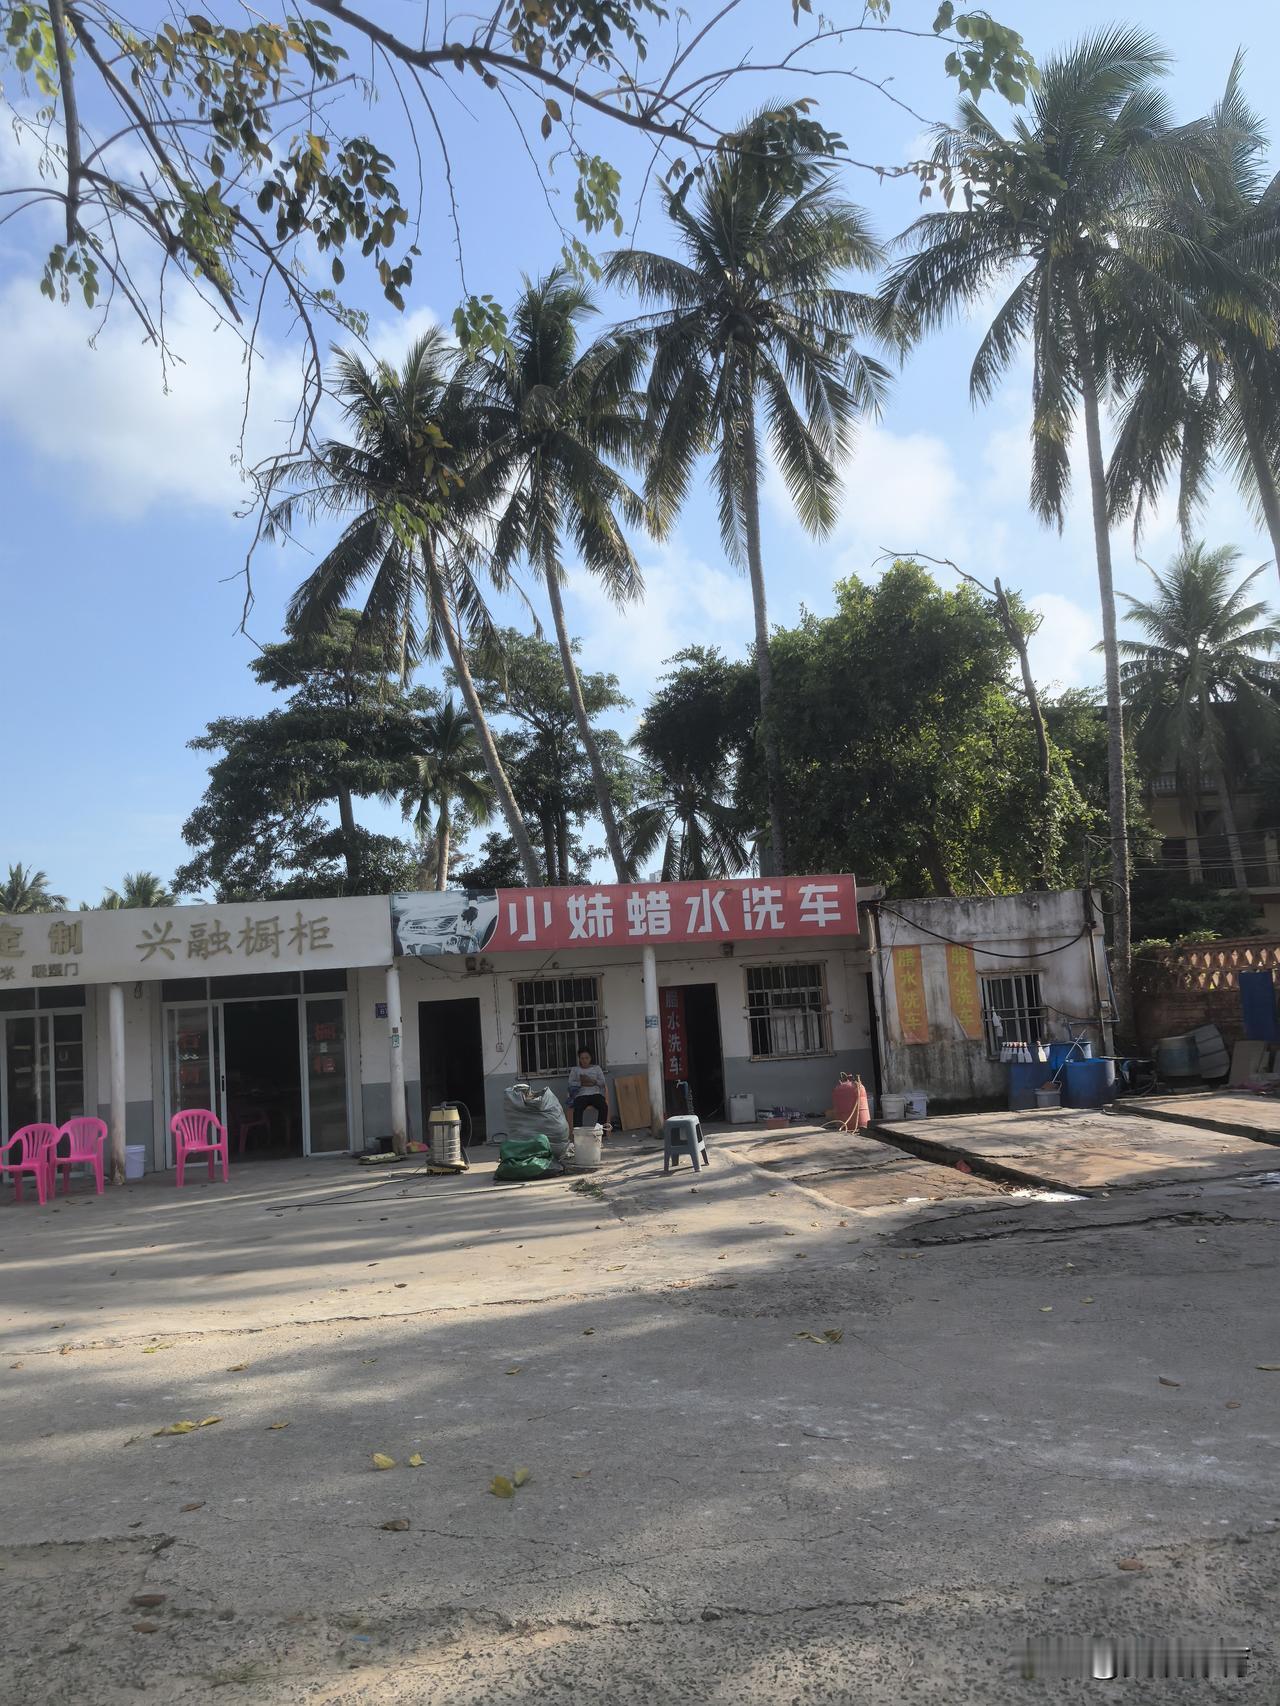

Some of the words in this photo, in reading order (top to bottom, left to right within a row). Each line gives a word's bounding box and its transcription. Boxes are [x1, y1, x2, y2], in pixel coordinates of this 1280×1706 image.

[136, 911, 335, 962] 兴融橱柜
[508, 883, 841, 943] 小妹蜡水洗车
